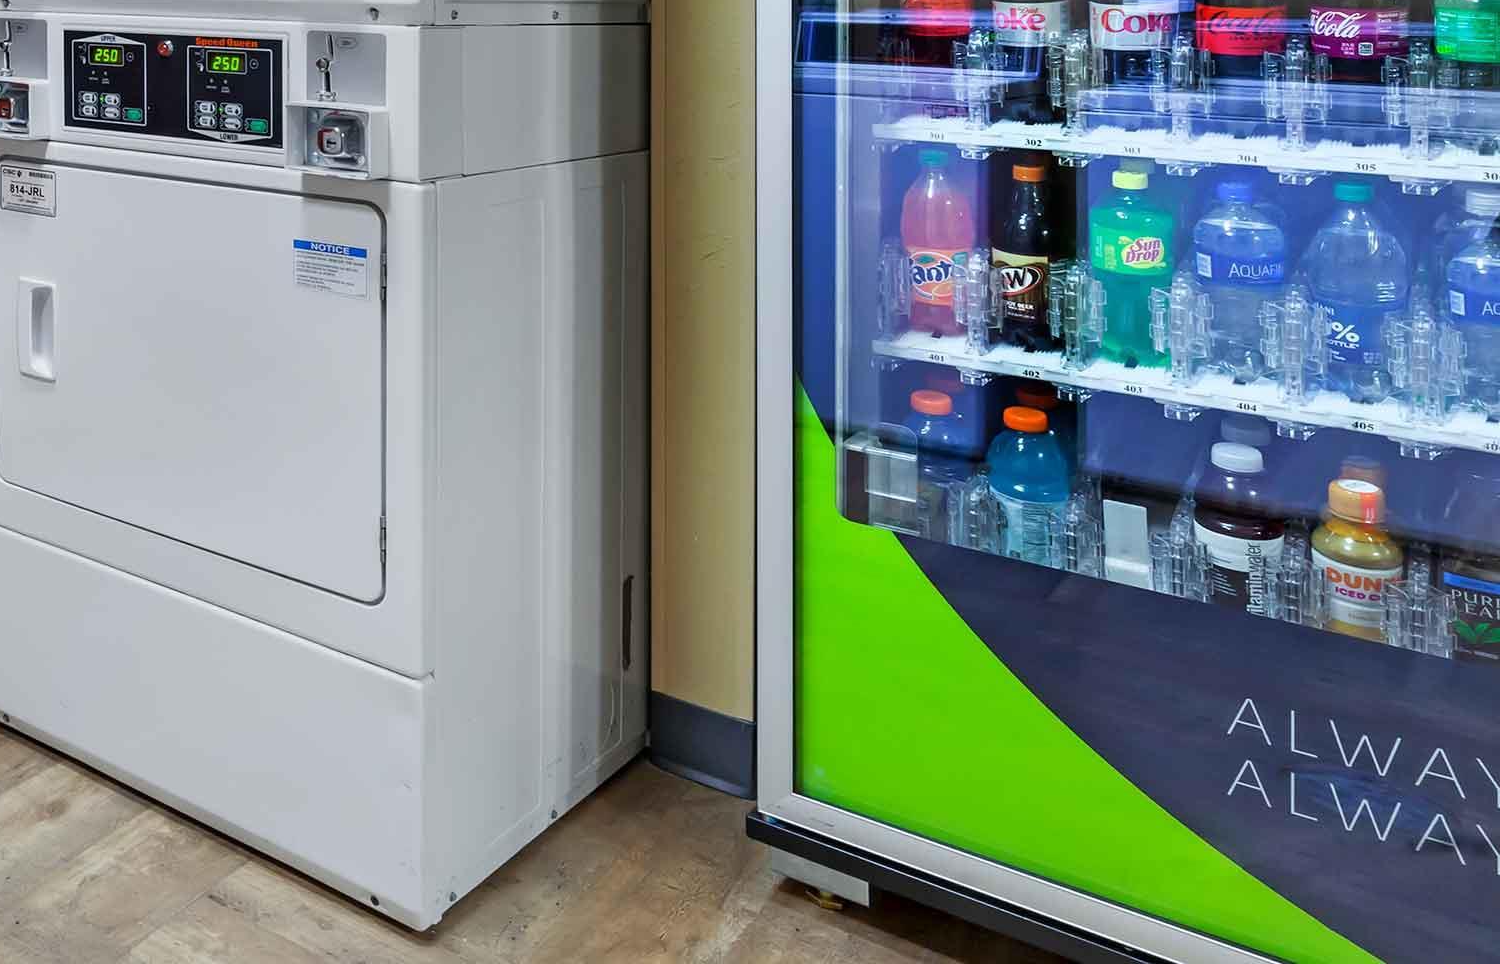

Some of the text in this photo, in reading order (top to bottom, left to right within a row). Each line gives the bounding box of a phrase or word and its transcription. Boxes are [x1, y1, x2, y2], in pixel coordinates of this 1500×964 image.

[995, 8, 1046, 31] oke
[94, 48, 118, 63] 250
[212, 56, 240, 71] 250
[929, 132, 945, 140] 301
[1024, 138, 1043, 147] 302
[1124, 146, 1141, 155] 303
[1237, 155, 1258, 163] 304
[1355, 163, 1377, 172] 305
[1483, 172, 1500, 180] 30
[10, 183, 45, 198] 814-JRL
[310, 242, 350, 255] NOTICE
[1130, 238, 1161, 252] Sun
[1125, 249, 1161, 264] Drop
[912, 261, 952, 285] ant
[928, 354, 945, 362] 401
[1022, 369, 1040, 378] 402
[1124, 385, 1143, 394] 403
[1236, 402, 1257, 412] 404
[1351, 421, 1375, 432] 405
[1484, 443, 1500, 451] 40
[1335, 586, 1366, 600] ICED
[1227, 698, 1500, 809] ALWAY
[1227, 760, 1500, 876] ALWAY
